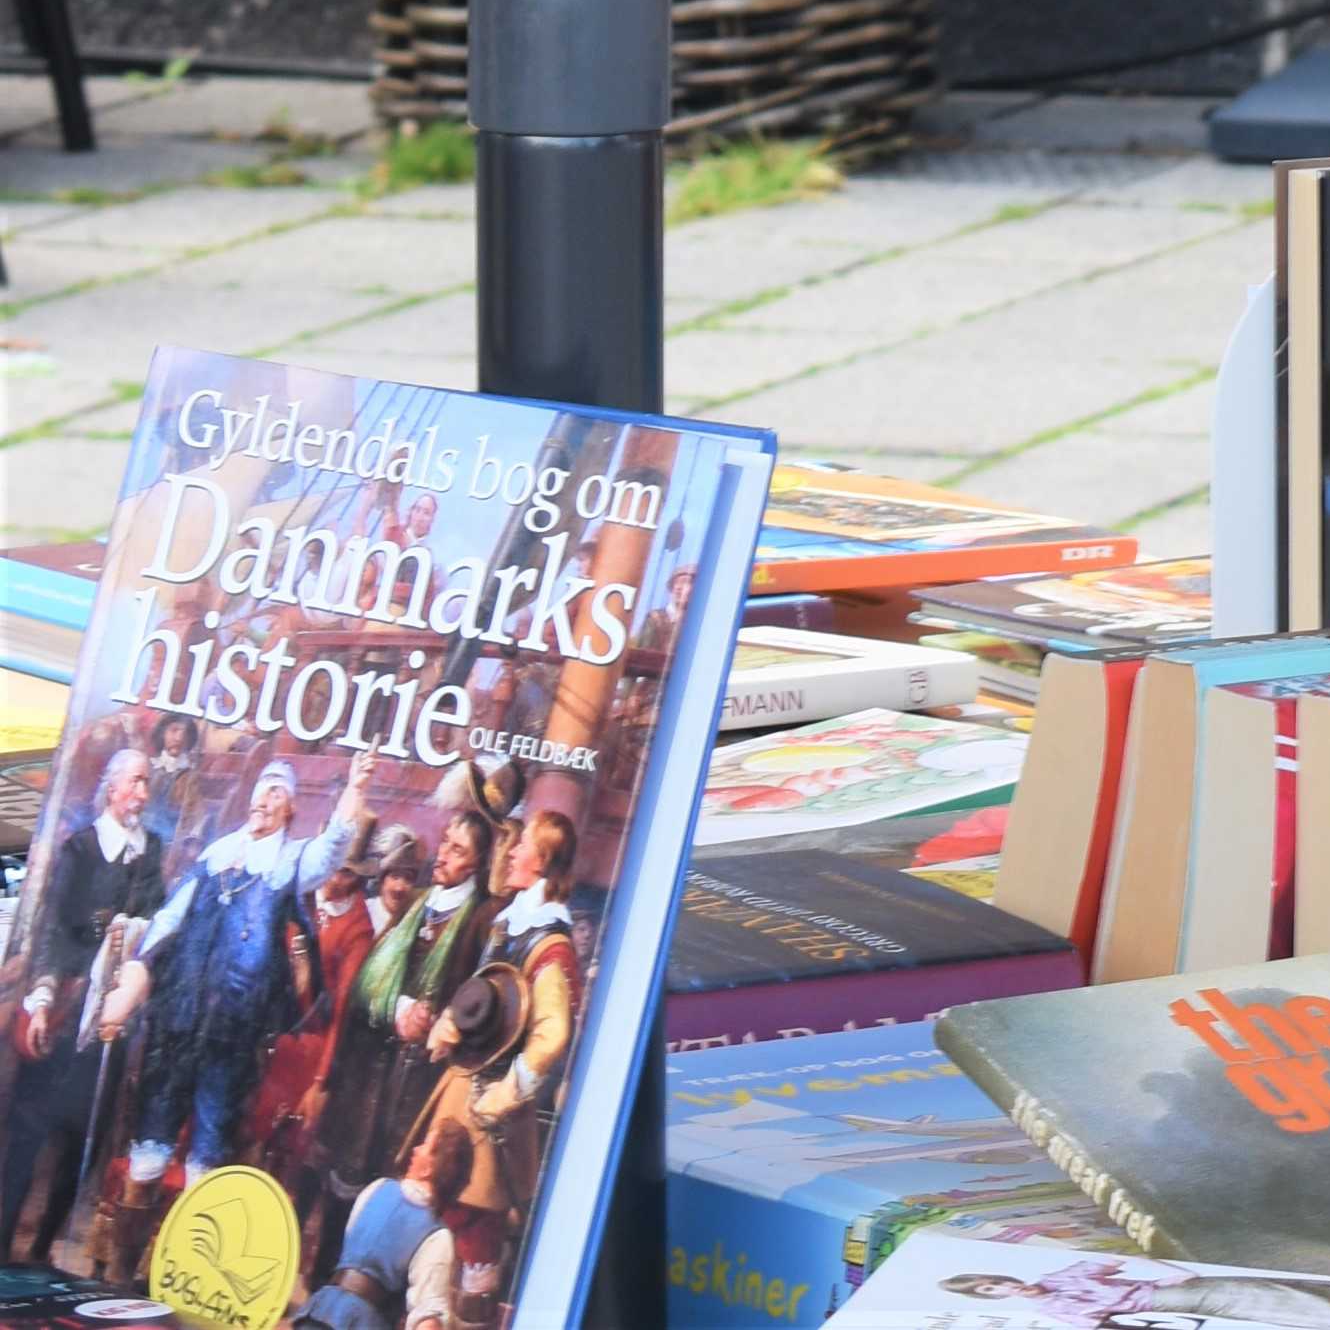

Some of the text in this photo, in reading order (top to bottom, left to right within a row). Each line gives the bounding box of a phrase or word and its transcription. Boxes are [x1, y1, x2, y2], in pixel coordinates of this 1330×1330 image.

[177, 388, 664, 534] Gyldendals bog om
[141, 471, 639, 667] Danmarks
[110, 587, 473, 769] historie
[468, 725, 600, 774] OLE FELDBÆK
